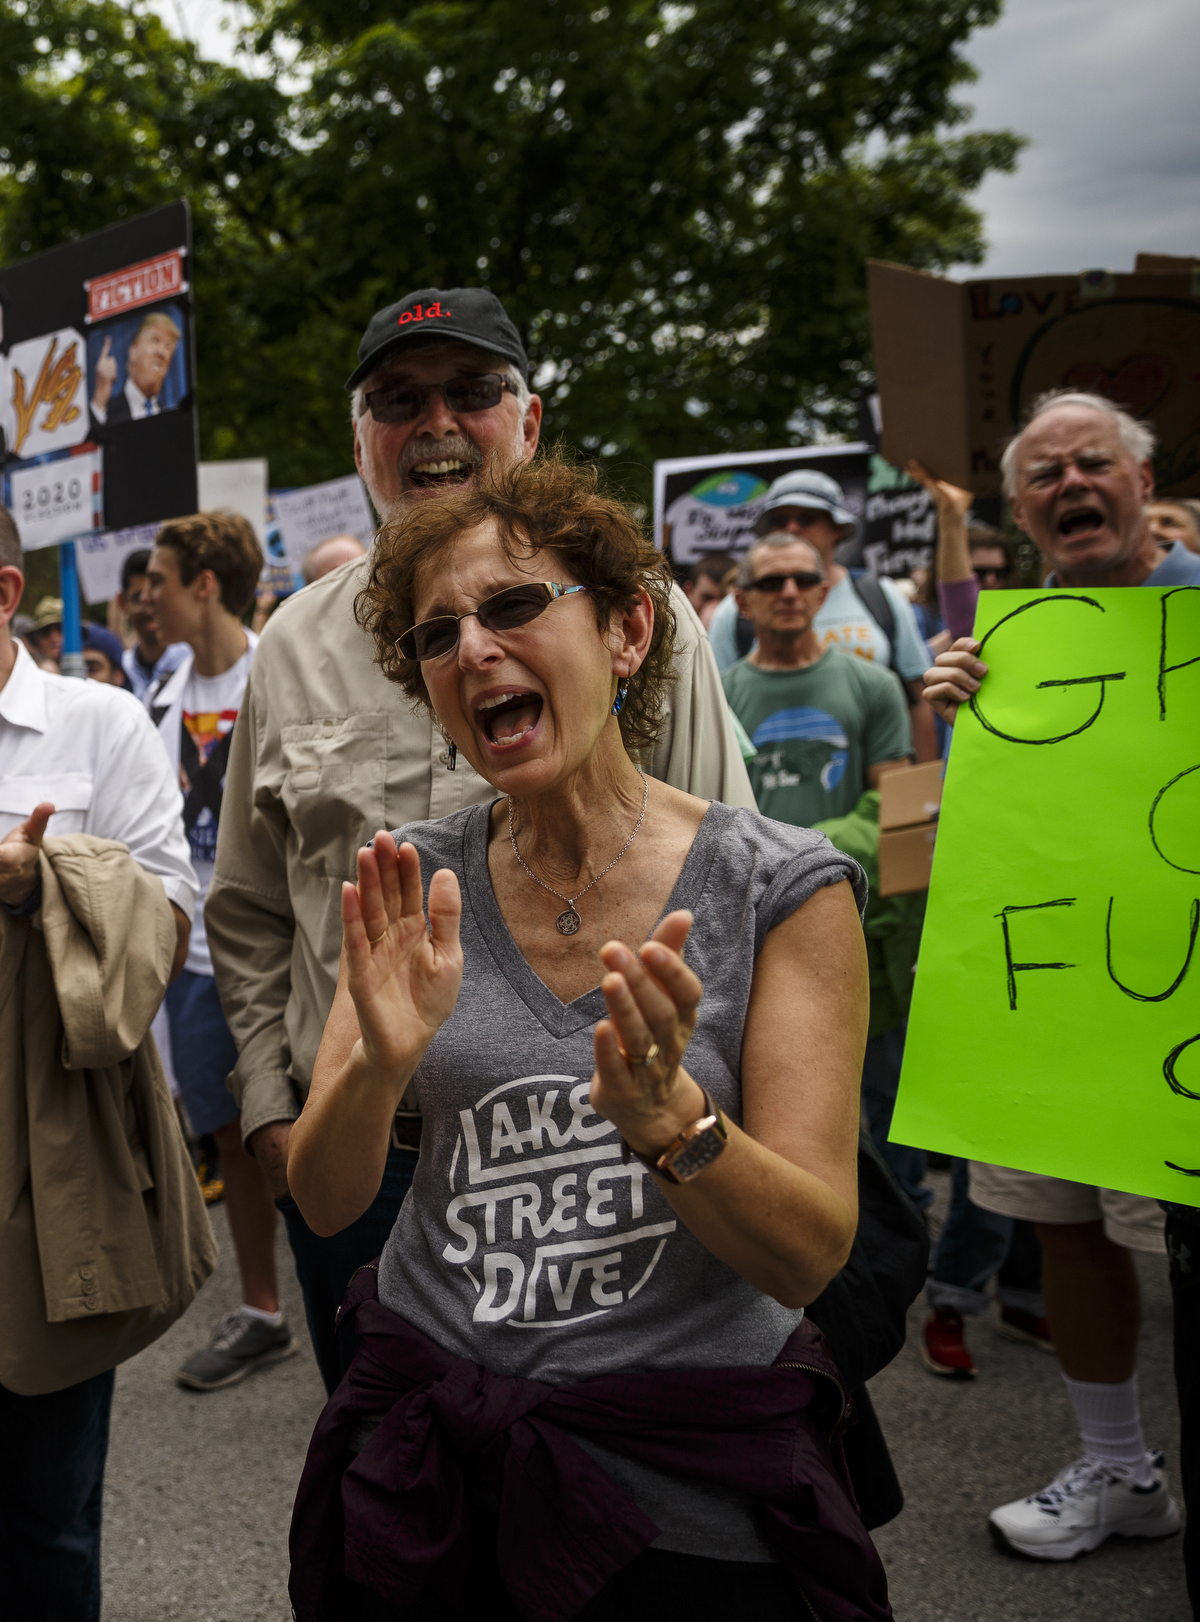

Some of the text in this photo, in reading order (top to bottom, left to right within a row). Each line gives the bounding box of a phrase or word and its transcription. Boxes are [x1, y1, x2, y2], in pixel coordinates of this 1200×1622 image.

[98, 259, 176, 311] FICTION
[397, 301, 452, 325] old.
[22, 477, 83, 511] 2020
[22, 501, 83, 524] ELECTION
[460, 1081, 621, 1184] LAKE
[442, 1162, 649, 1263] STREET
[473, 1247, 626, 1322] DIVE
